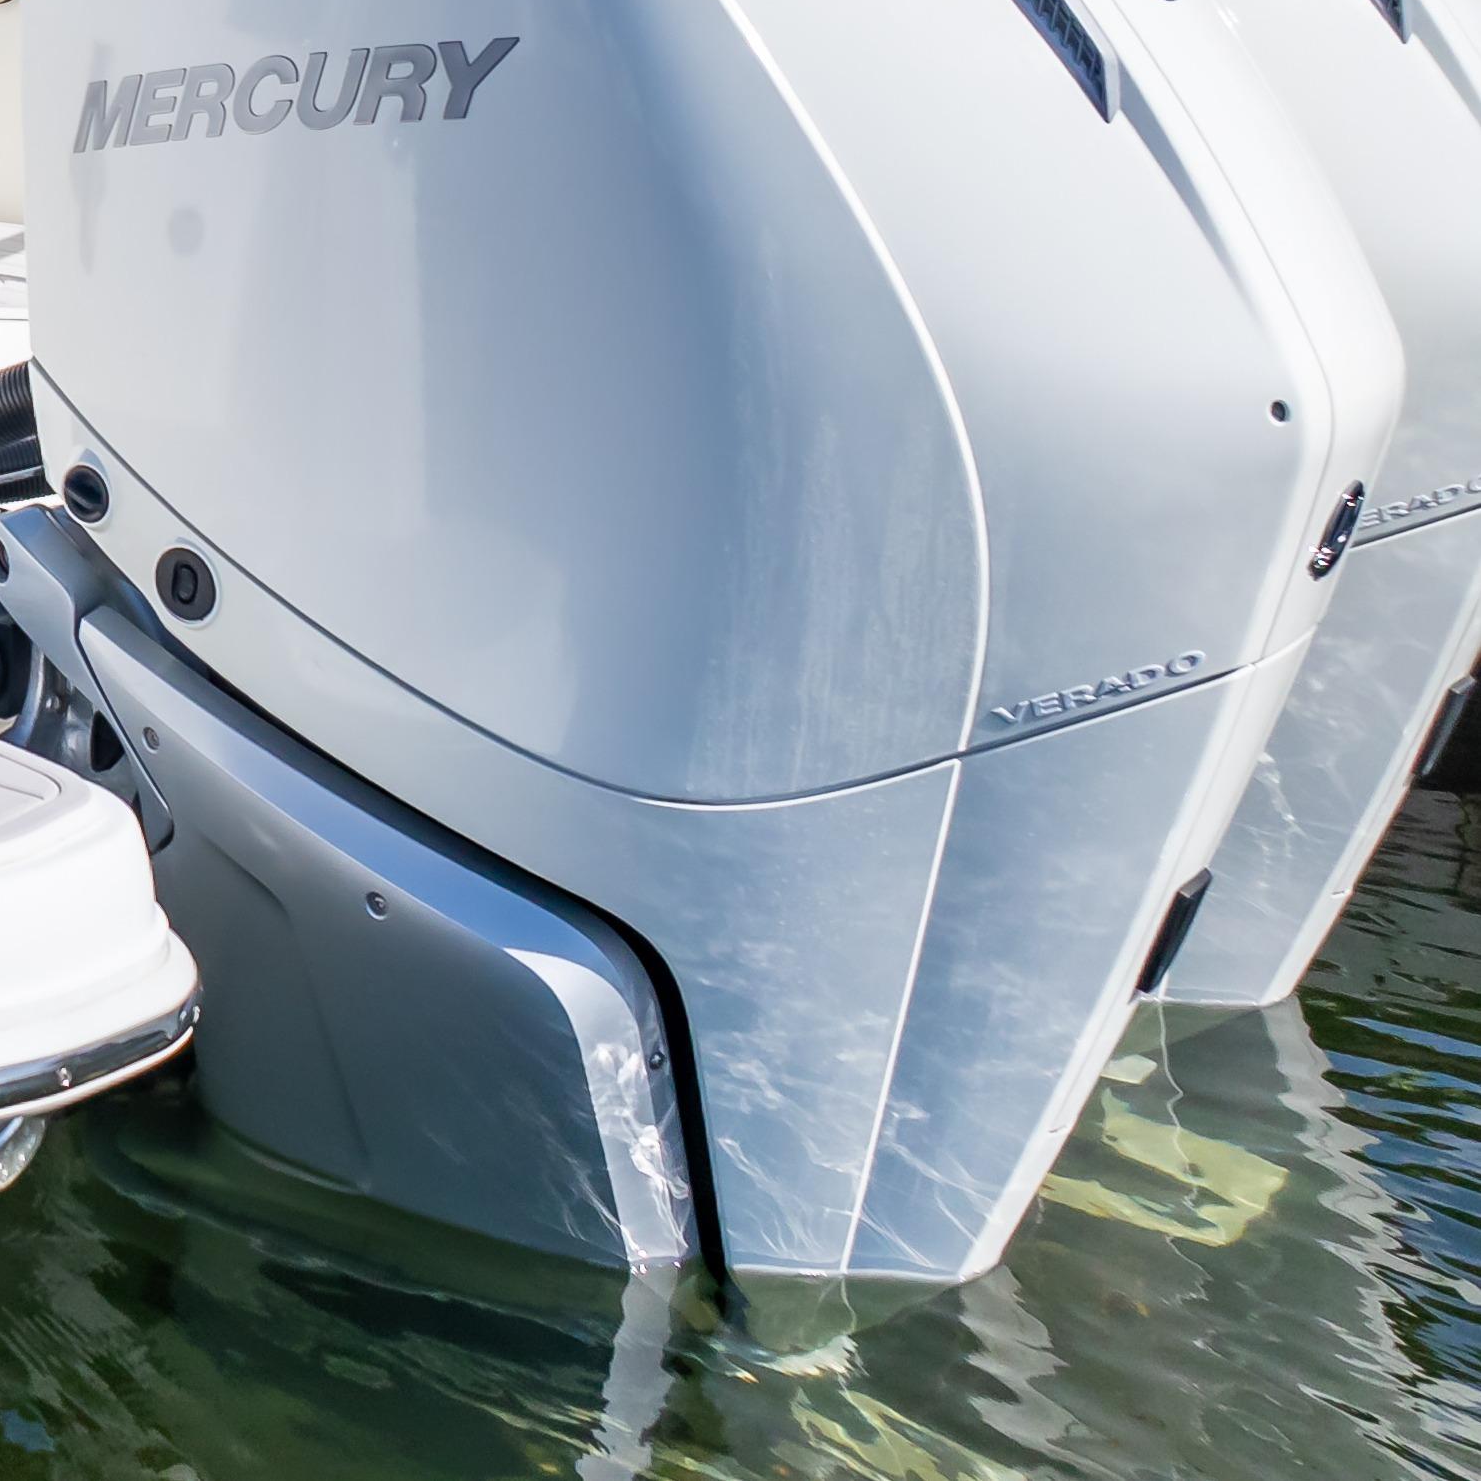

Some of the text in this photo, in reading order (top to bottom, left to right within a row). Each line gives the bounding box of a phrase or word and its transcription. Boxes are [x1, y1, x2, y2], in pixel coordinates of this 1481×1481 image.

[72, 36, 520, 153] MERCURY
[1360, 480, 1481, 531] ERAD
[990, 650, 1206, 723] VERADO
